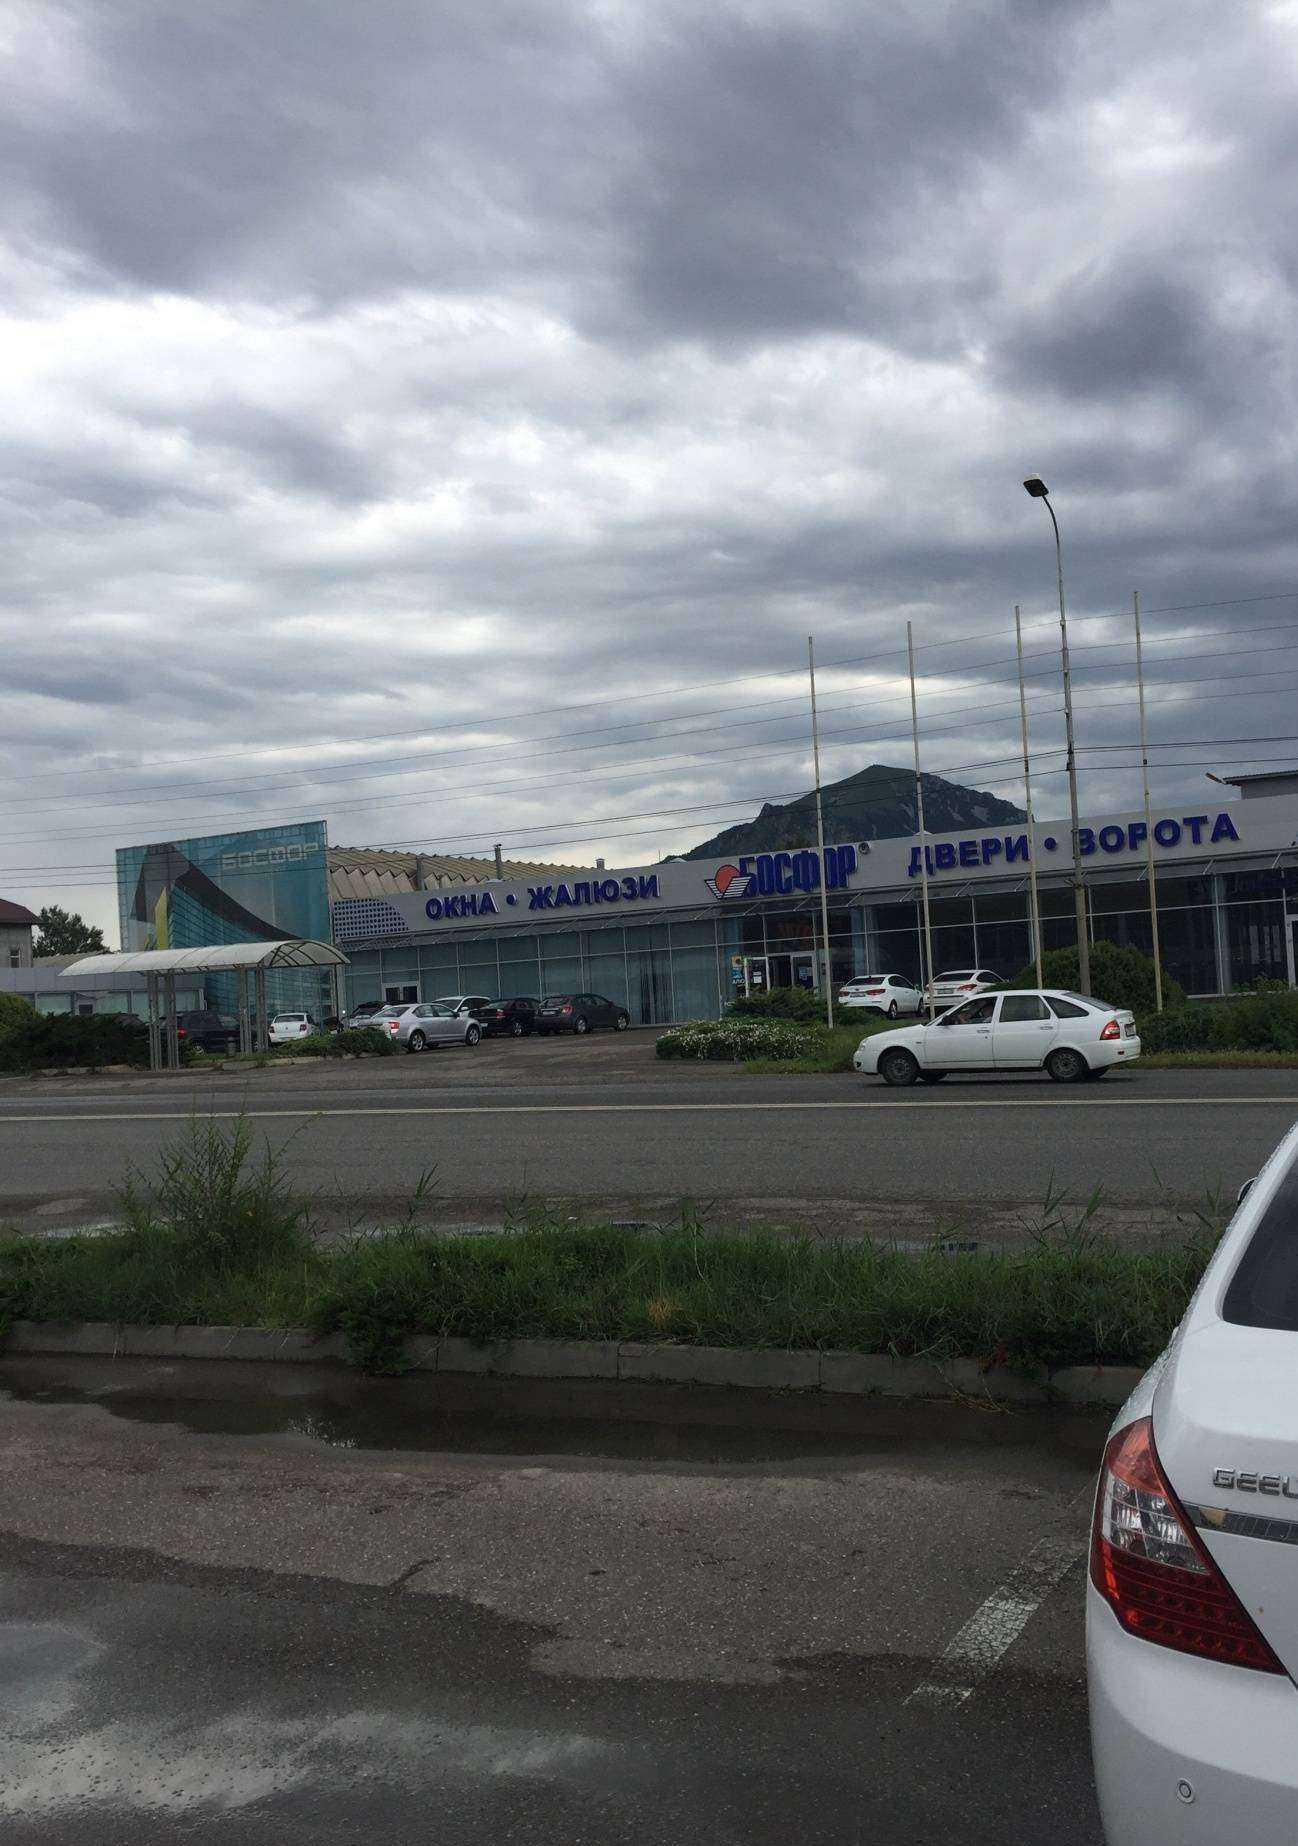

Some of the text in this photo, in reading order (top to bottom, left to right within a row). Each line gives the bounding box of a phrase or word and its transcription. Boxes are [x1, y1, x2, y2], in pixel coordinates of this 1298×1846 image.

[739, 845, 858, 899] БОСФОР
[908, 813, 1241, 877] ДВЕРИ ВОРОТА
[425, 874, 661, 921] ОКНА ЖАЛЮЗИ
